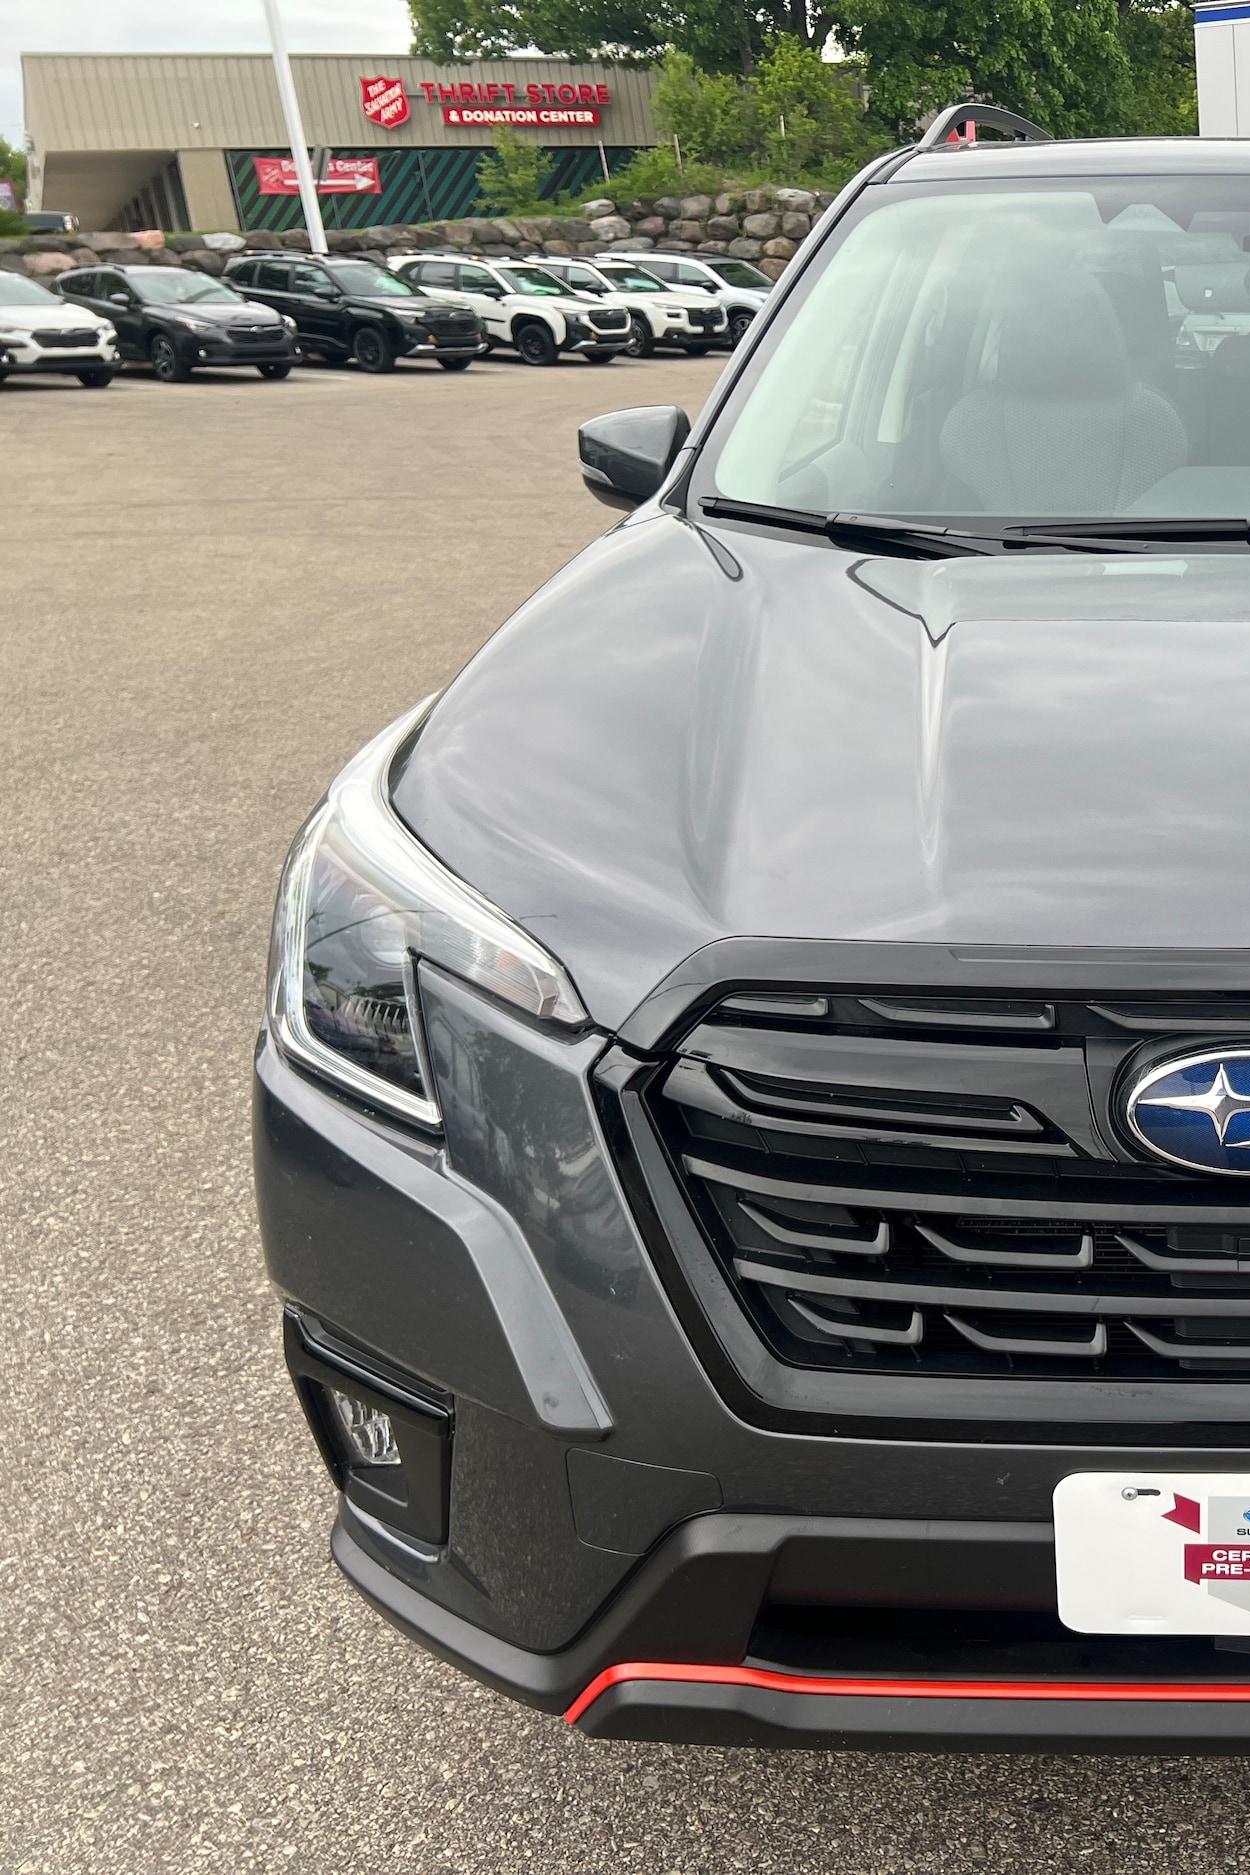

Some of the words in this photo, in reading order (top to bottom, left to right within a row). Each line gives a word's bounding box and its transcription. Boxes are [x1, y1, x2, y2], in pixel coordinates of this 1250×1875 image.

[367, 80, 386, 98] THE
[419, 82, 515, 104] THRIFT
[525, 83, 611, 105] STORE
[380, 97, 403, 122] ARMY
[449, 110, 460, 122] &
[462, 110, 538, 123] DONATION
[539, 111, 594, 123] CENTER
[335, 160, 374, 173] Center
